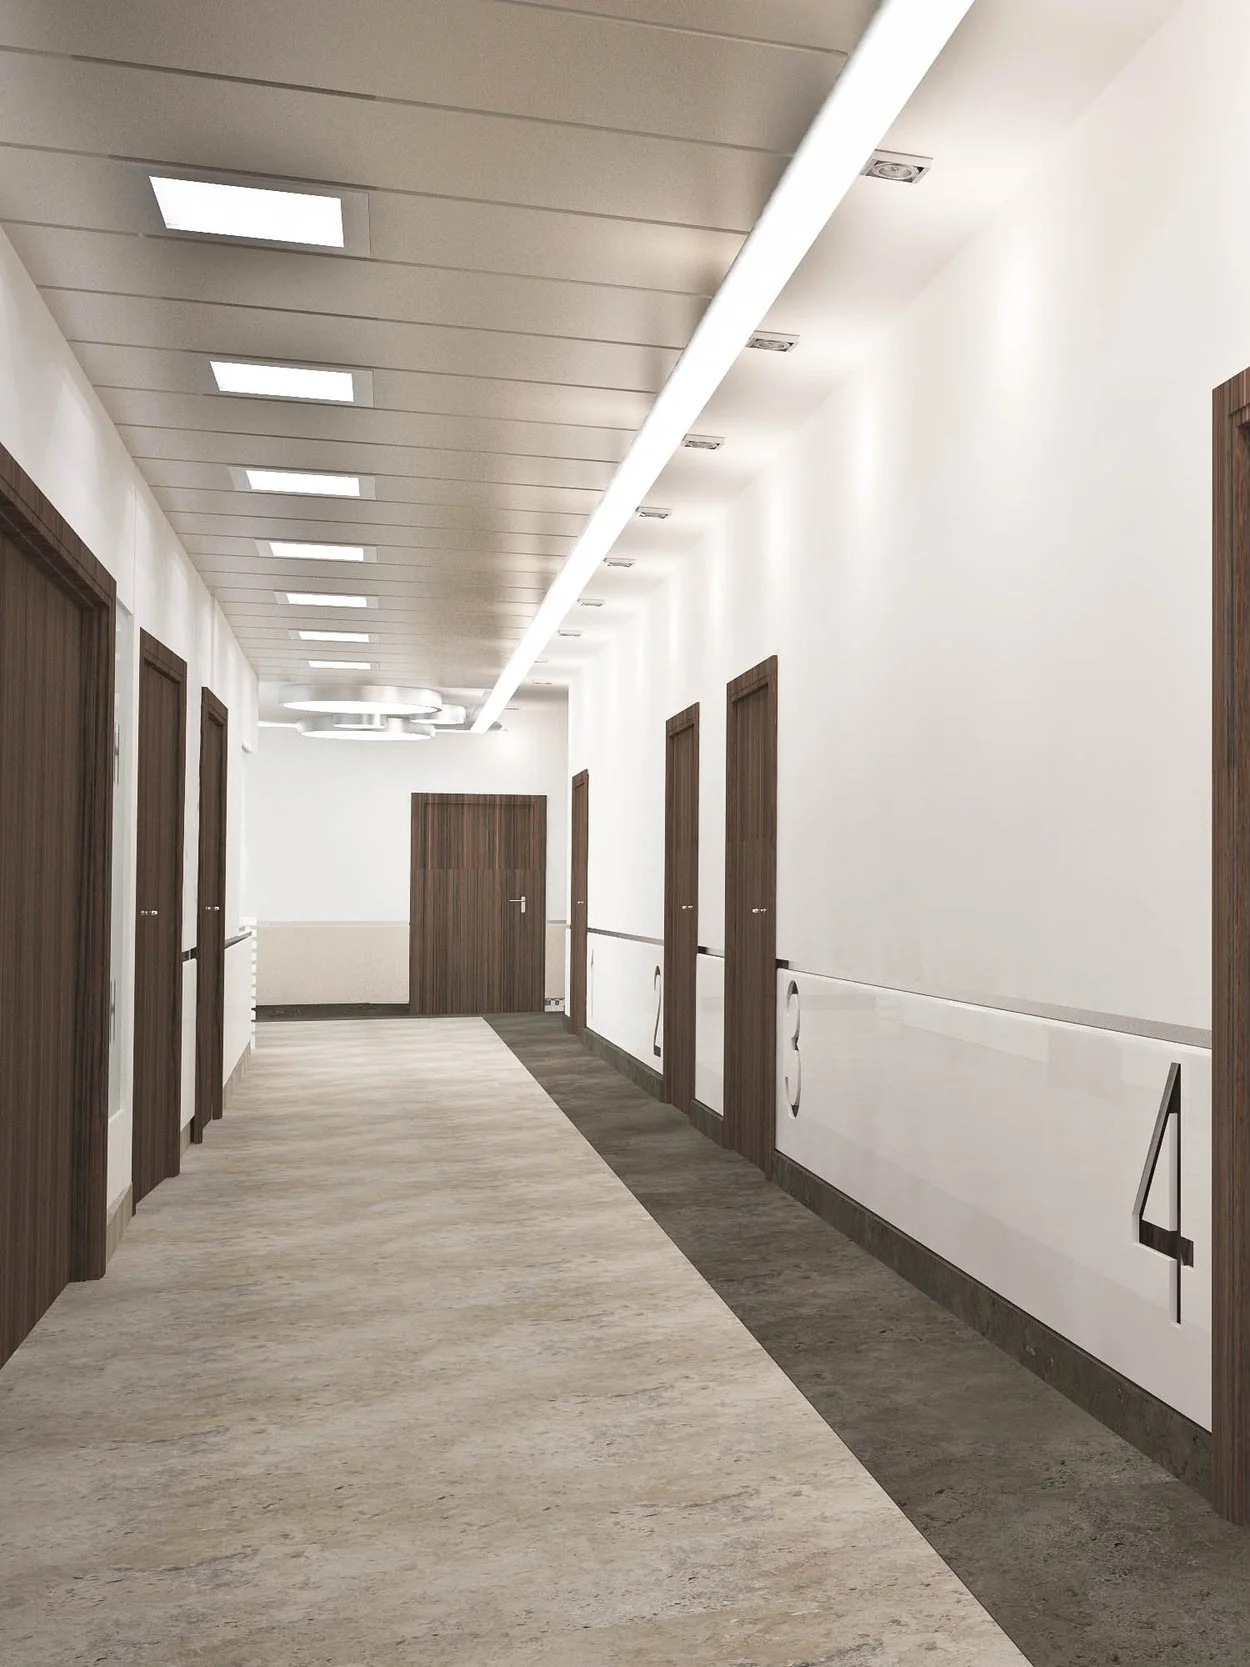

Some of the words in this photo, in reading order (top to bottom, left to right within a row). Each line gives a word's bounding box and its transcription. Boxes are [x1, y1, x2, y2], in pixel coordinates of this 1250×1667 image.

[653, 965, 661, 1058] 2
[785, 980, 801, 1119] 3
[1132, 1062, 1194, 1328] 4
